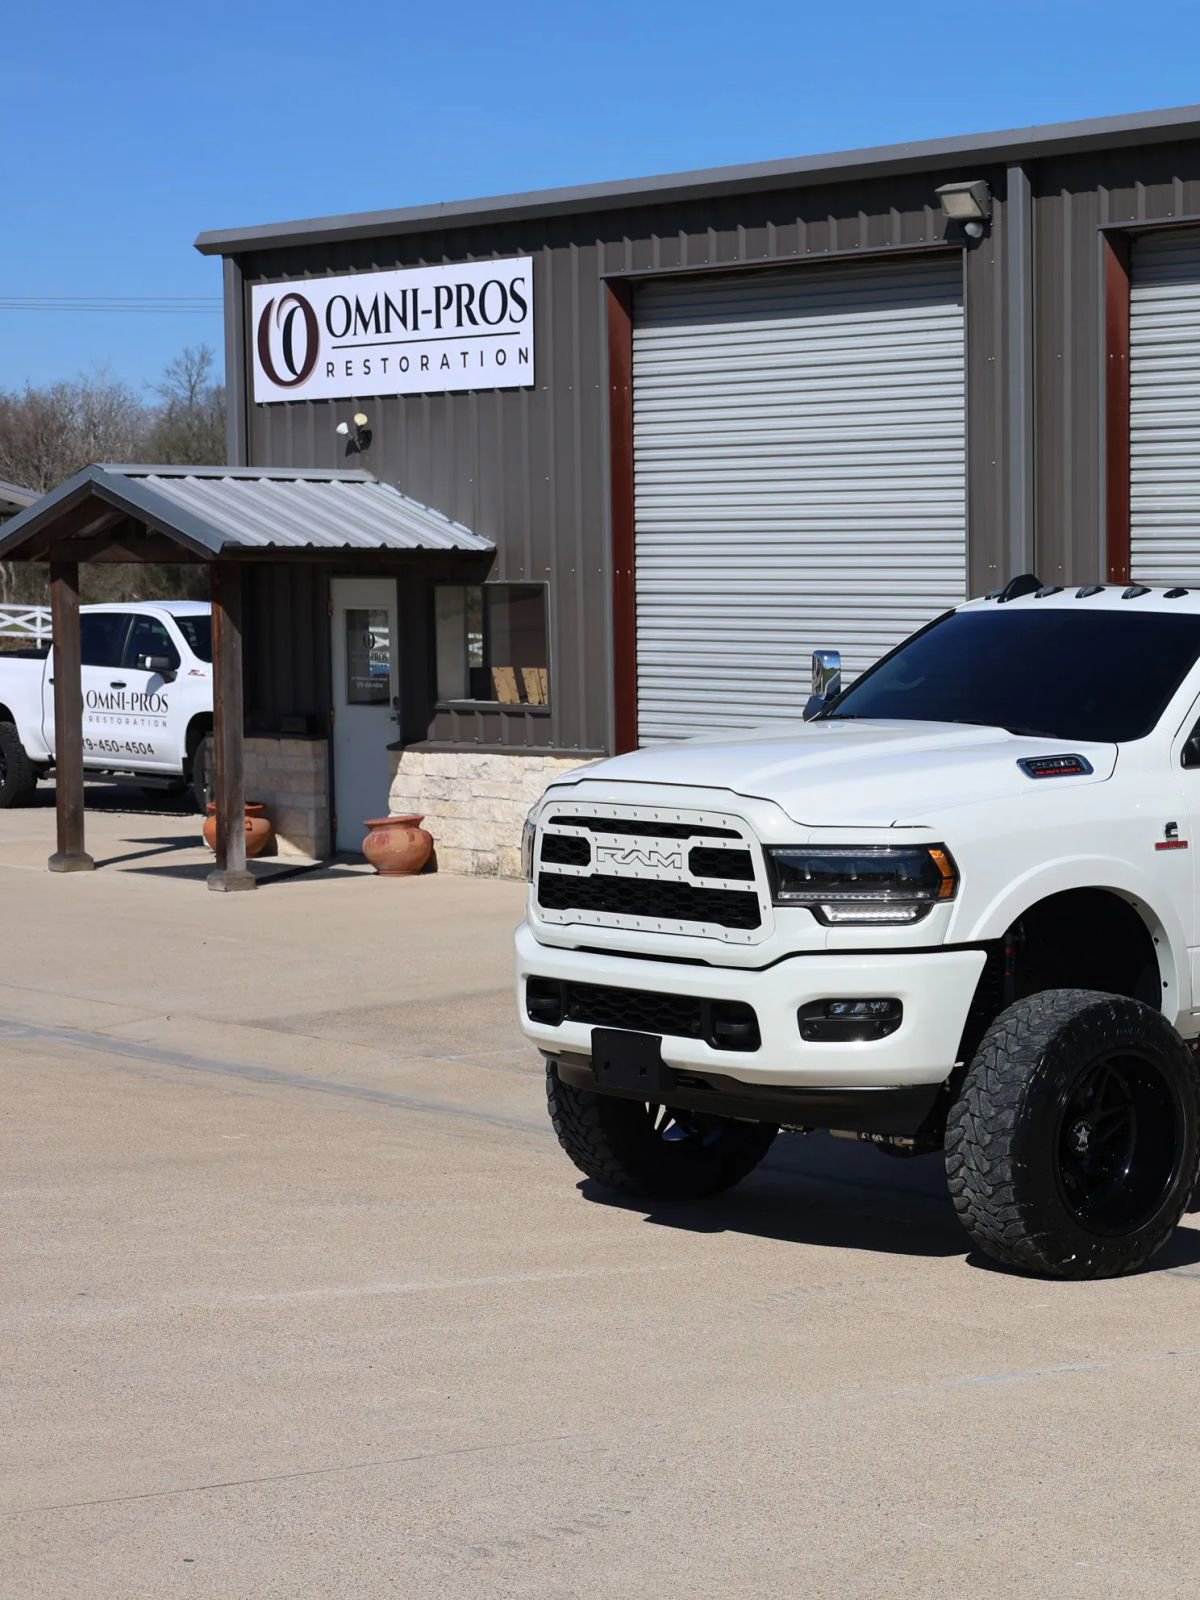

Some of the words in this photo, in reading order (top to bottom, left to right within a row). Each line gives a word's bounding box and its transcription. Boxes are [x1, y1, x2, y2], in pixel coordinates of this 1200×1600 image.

[325, 277, 528, 338] OMNI-PROS
[326, 347, 529, 378] RESTORATION
[86, 689, 169, 713] OMNI-PROS
[88, 715, 168, 728] RESTORATION
[596, 846, 682, 869] RAM
